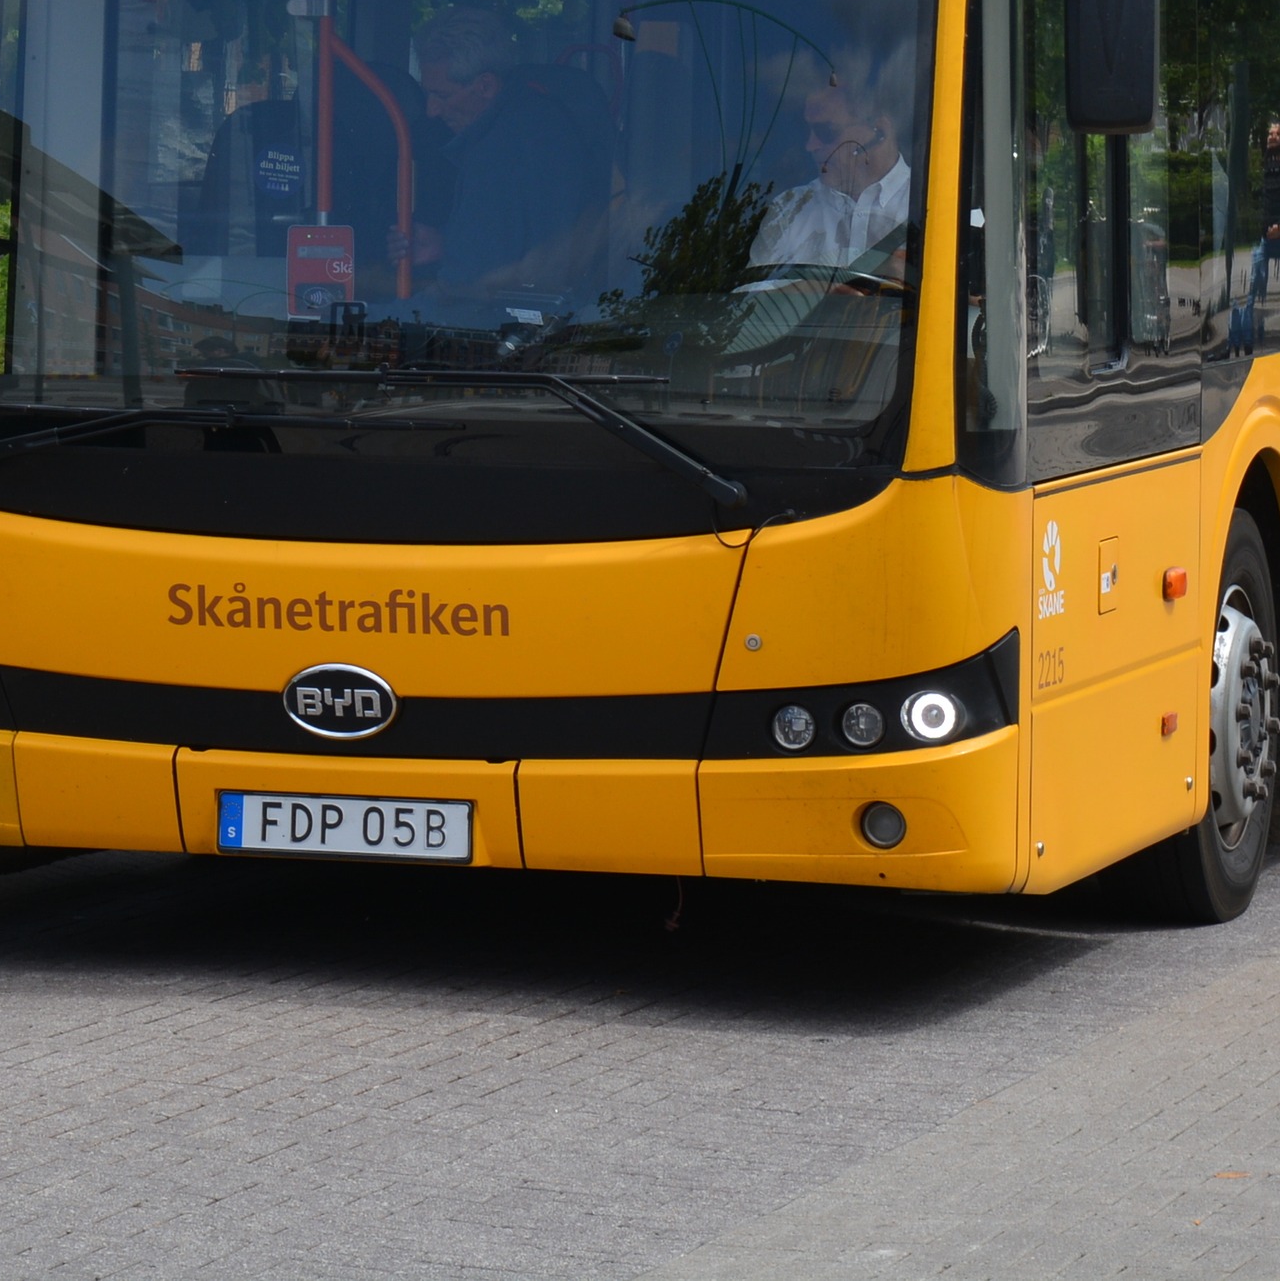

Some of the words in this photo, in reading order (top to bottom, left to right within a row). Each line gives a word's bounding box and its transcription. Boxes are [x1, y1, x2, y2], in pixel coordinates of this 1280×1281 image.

[260, 160, 274, 169] din
[276, 161, 300, 173] biljett
[267, 150, 295, 162] Blippa
[167, 580, 512, 639] Skånetrafiken
[1038, 646, 1065, 690] 2215
[296, 686, 382, 718] BYD
[227, 826, 236, 838] S
[260, 800, 344, 846] FDP
[361, 805, 447, 850] 05B
